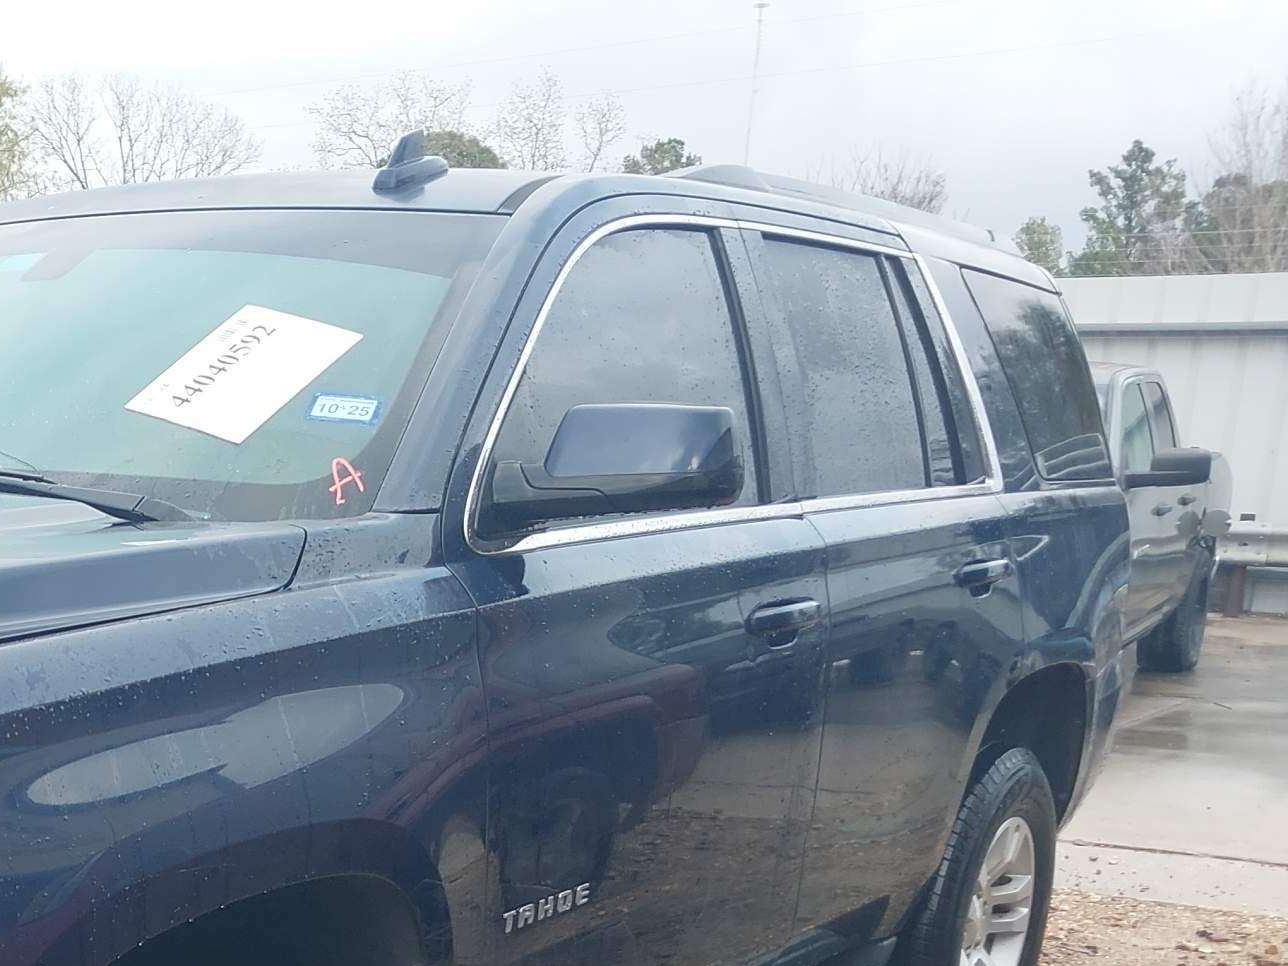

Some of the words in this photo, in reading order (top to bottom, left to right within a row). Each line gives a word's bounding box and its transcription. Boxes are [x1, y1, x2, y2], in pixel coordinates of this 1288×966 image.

[172, 325, 276, 407] 44040592
[328, 457, 364, 505] A
[503, 882, 590, 933] TAHOE
